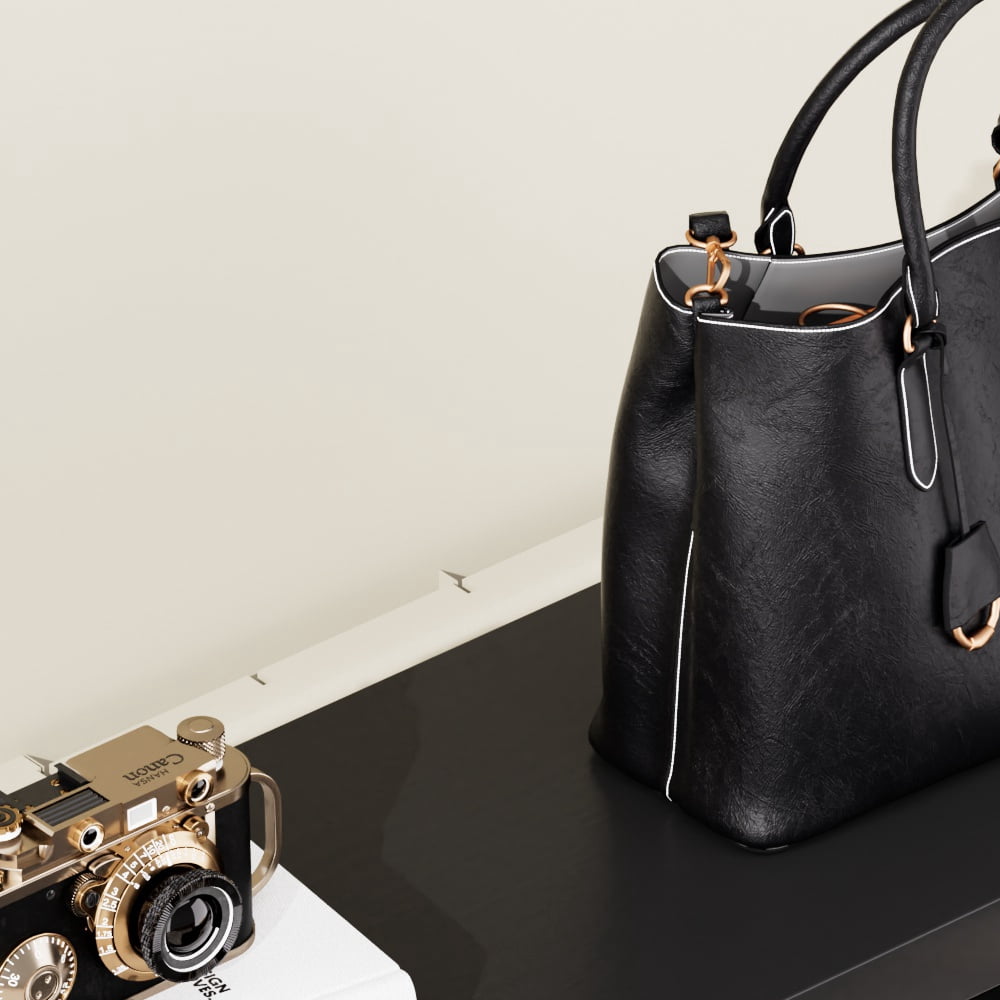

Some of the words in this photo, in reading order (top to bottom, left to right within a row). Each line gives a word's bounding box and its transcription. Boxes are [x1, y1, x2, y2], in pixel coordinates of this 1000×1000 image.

[122, 753, 185, 781] Canon
[132, 769, 170, 787] HANSA
[111, 887, 119, 896] 3
[8, 973, 20, 987] 30
[193, 979, 217, 1000] VES.
